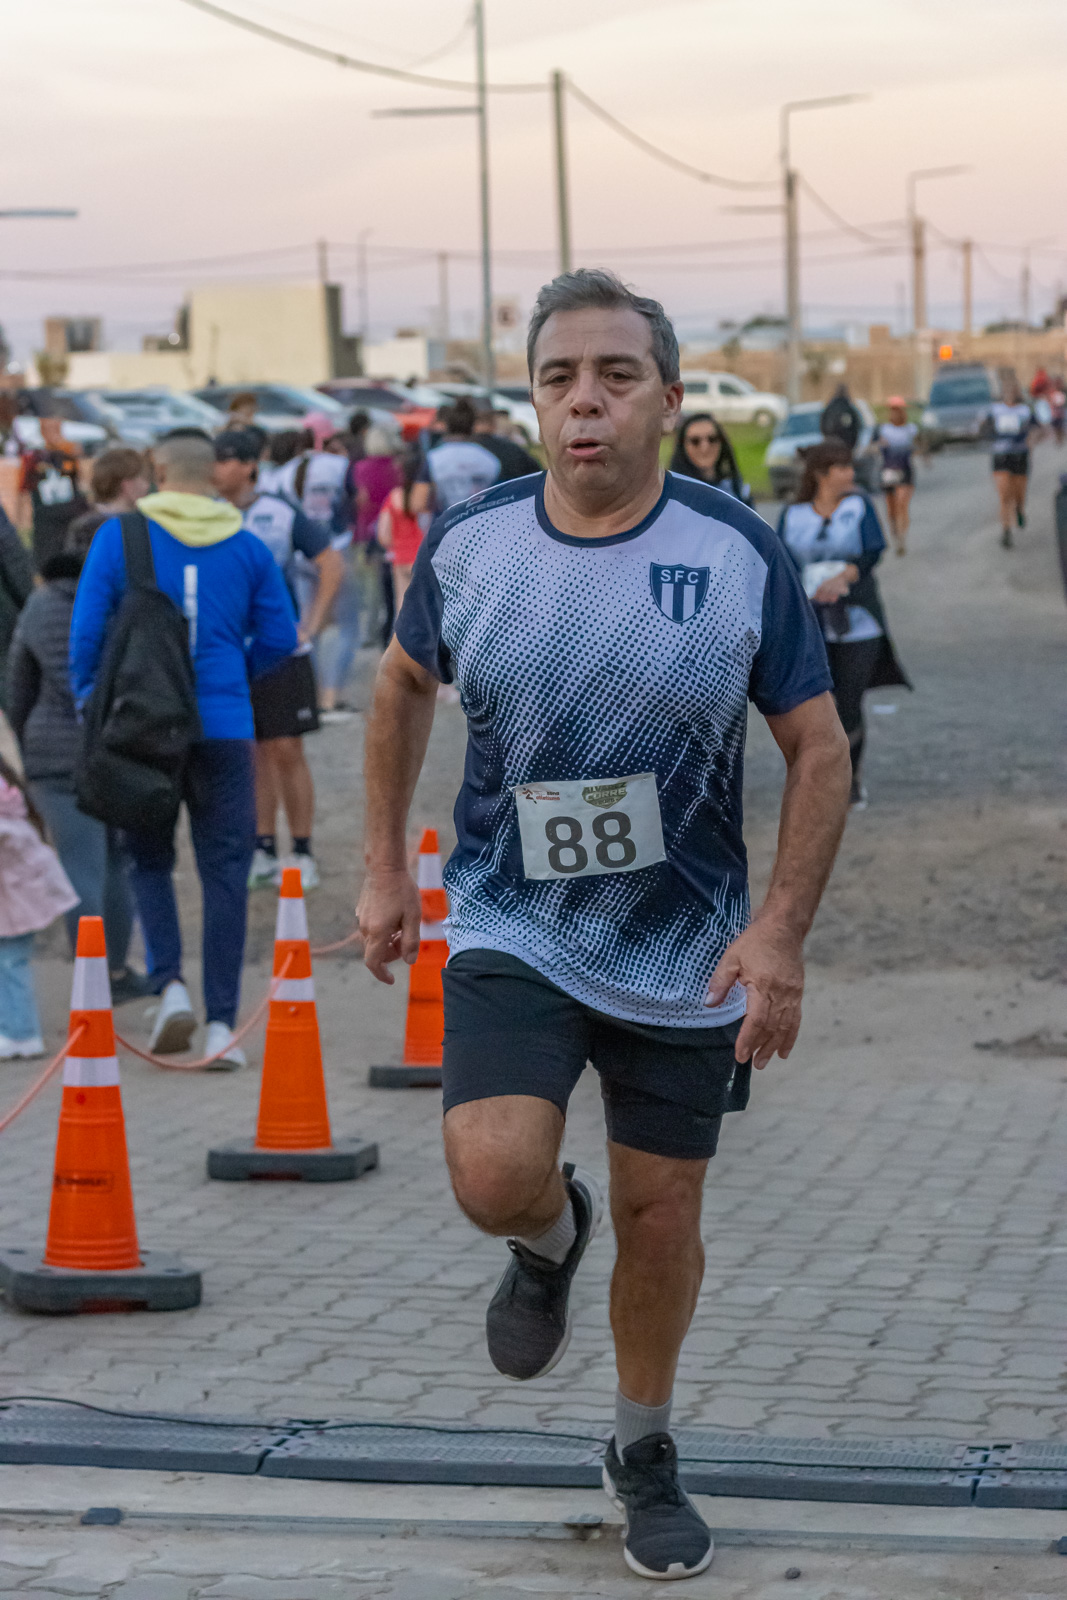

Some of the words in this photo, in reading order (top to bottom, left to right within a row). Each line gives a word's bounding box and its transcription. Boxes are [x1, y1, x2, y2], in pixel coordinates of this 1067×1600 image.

[444, 494, 515, 529] BONTEBOK
[660, 569, 699, 584] SFC
[585, 787, 626, 801] CORRE
[545, 811, 637, 874] 88
